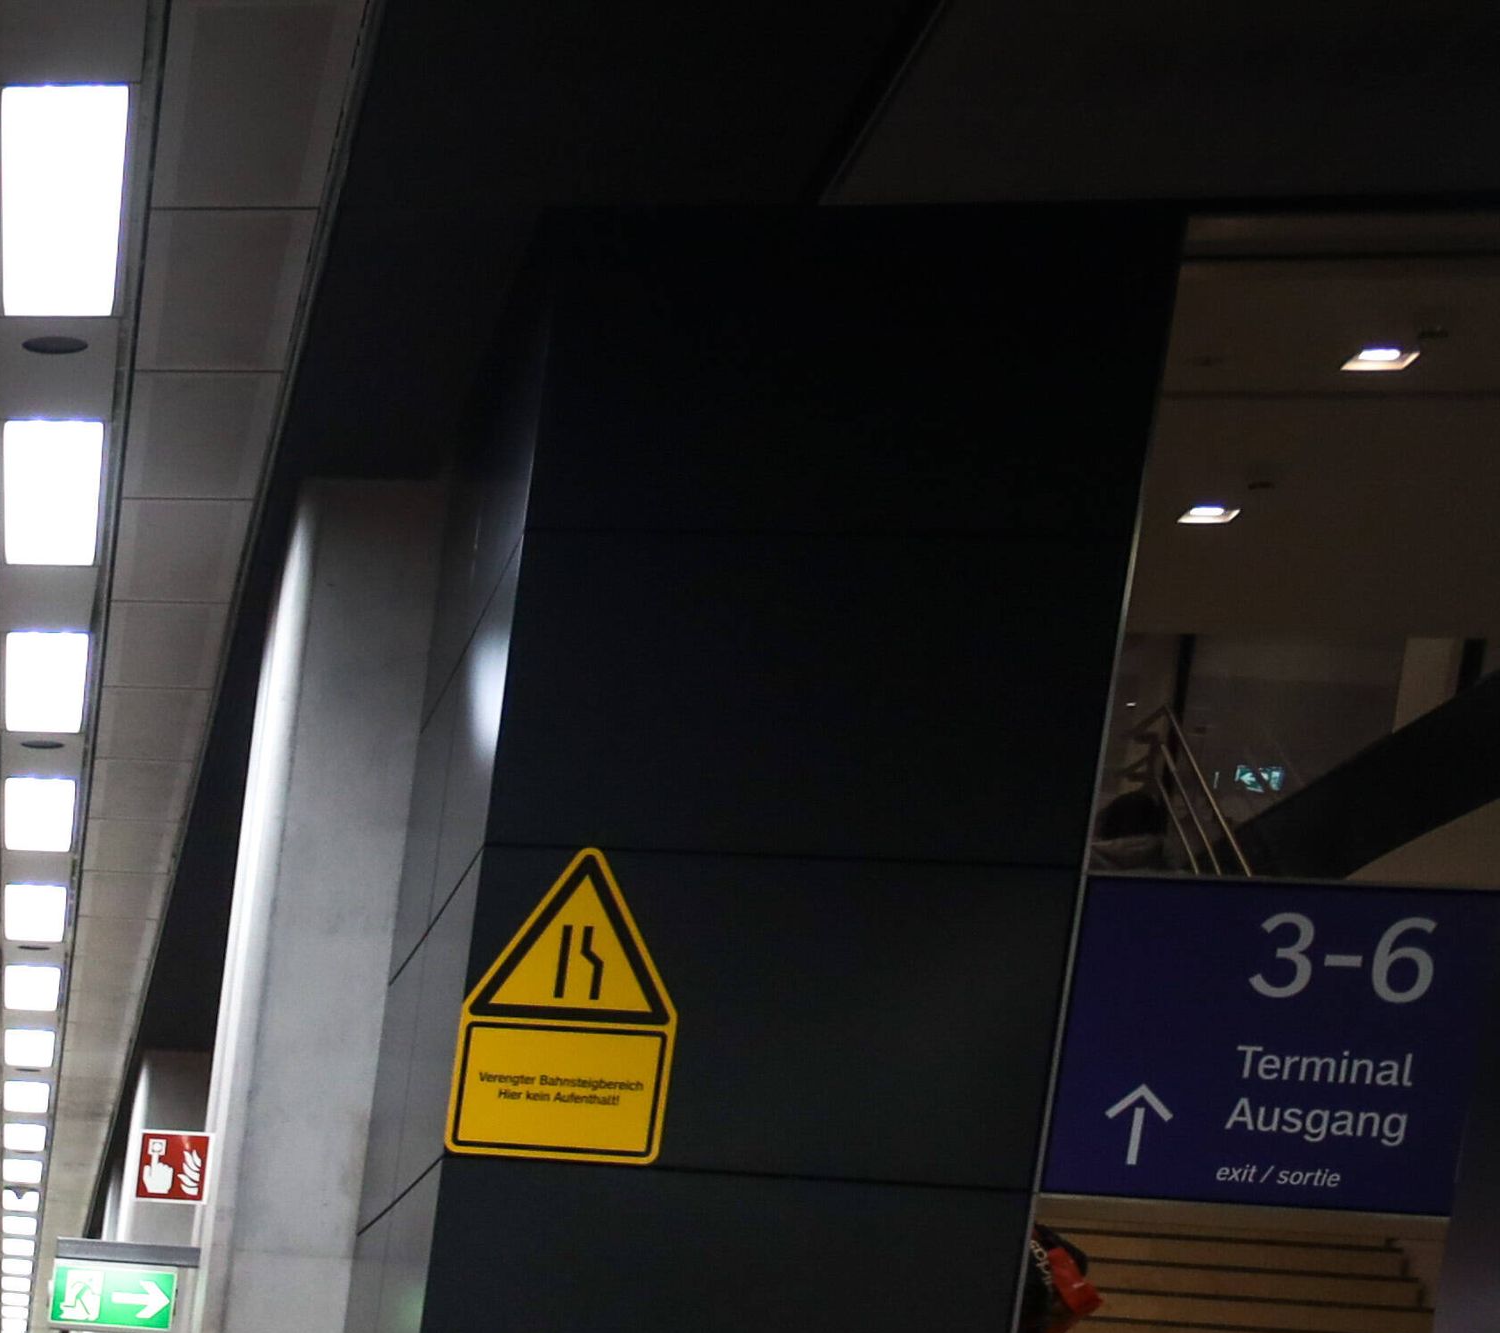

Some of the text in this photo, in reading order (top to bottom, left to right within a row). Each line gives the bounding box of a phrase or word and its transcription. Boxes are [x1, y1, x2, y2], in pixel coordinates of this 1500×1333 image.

[1249, 912, 1437, 1003] 3-6
[478, 1072, 645, 1092] Verengter Bahnsteigbereich
[1237, 1045, 1413, 1087] Terminal
[498, 1088, 620, 1106] Hier kein Aufenthalt!
[1225, 1097, 1407, 1147] Ausgang
[1216, 1165, 1257, 1183] exit
[1276, 1169, 1341, 1188] sortie
